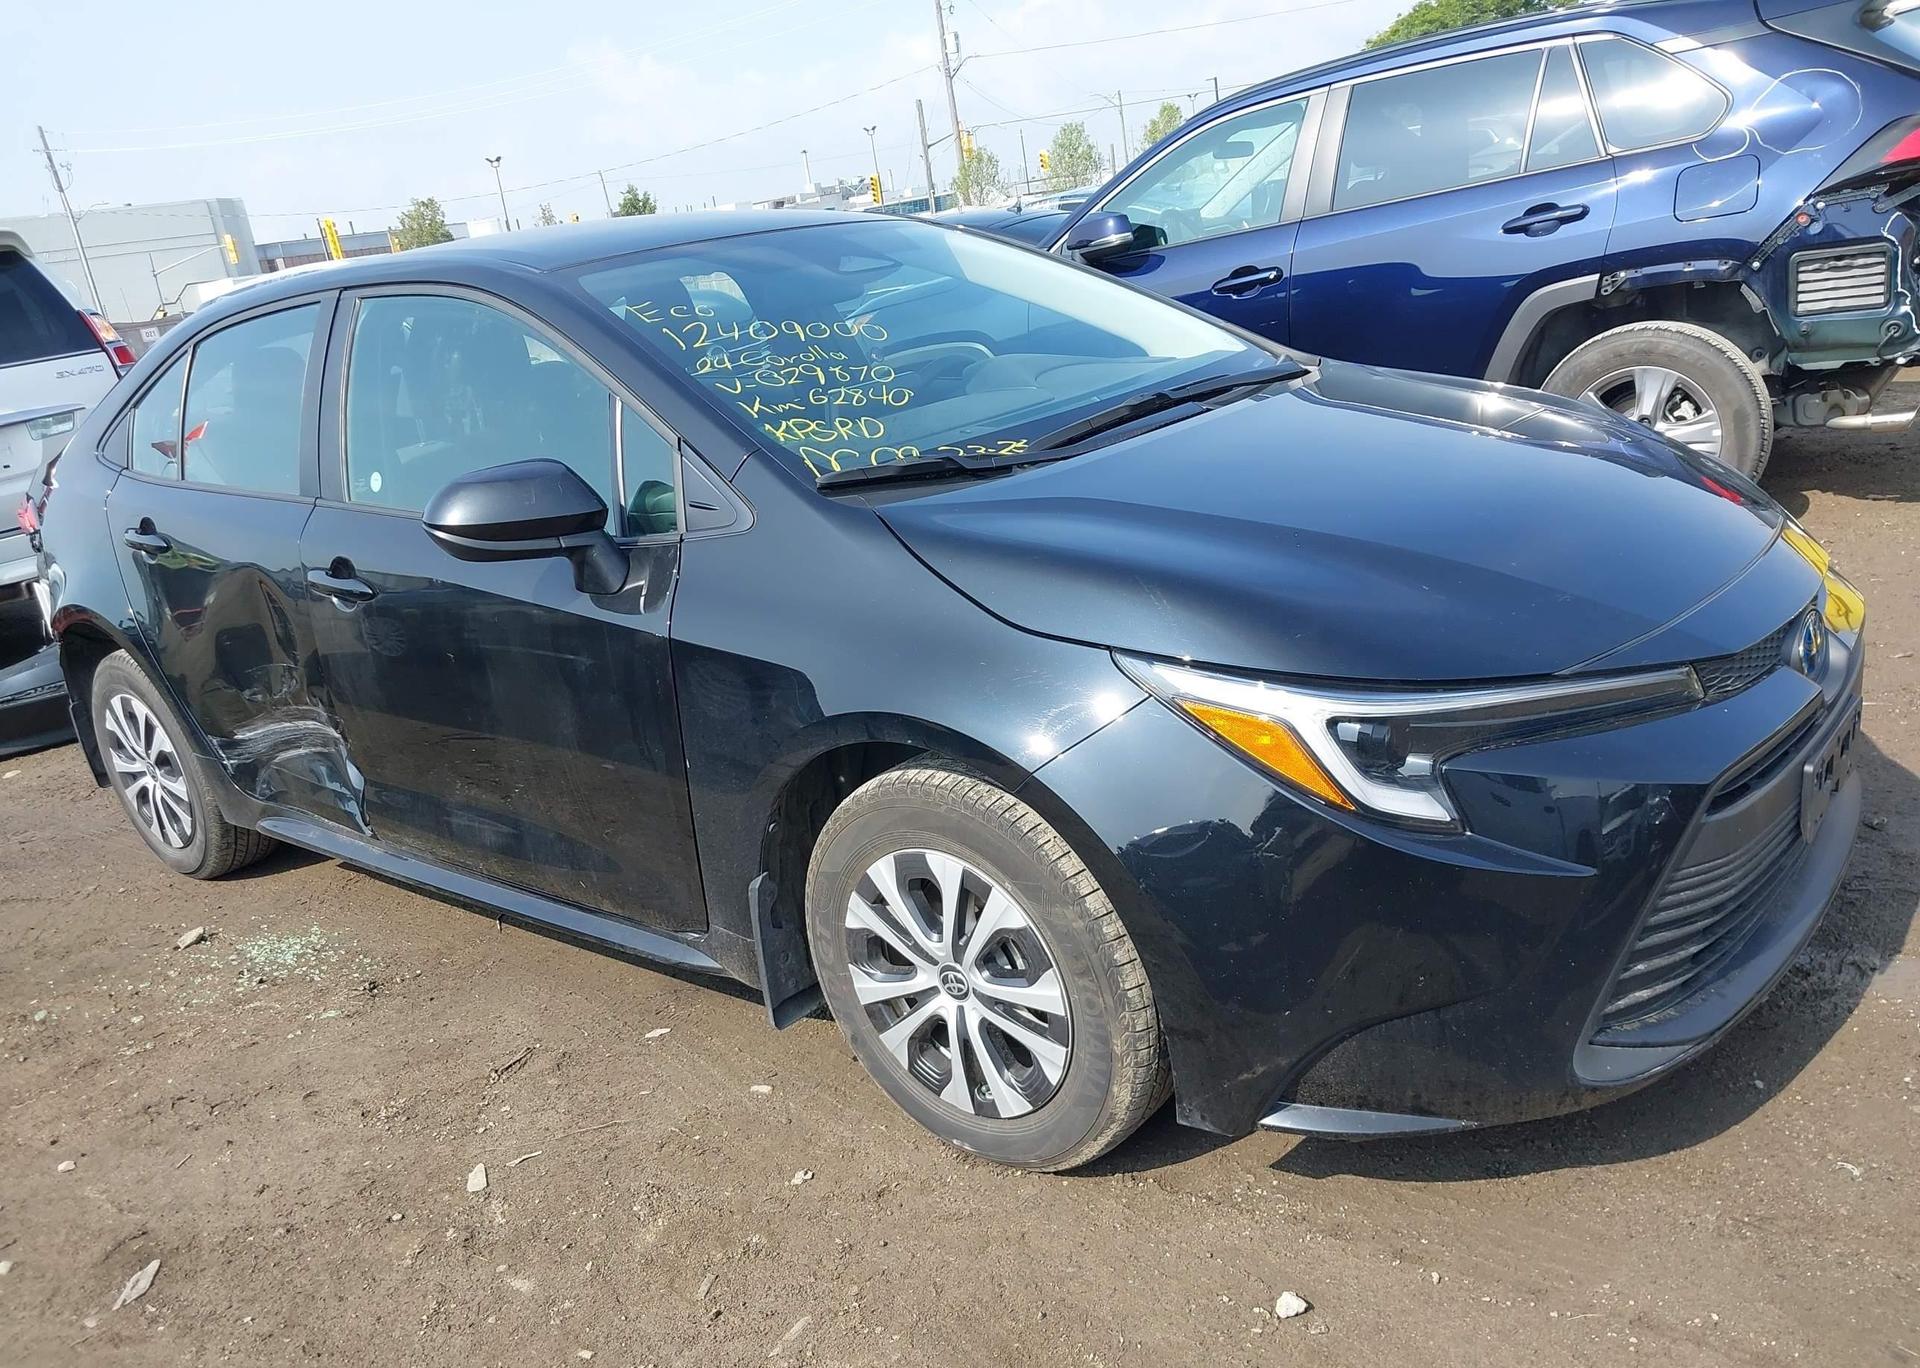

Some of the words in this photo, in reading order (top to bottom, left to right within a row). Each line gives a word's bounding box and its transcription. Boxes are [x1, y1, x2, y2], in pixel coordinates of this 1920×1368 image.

[662, 320, 888, 350] 12409000
[740, 344, 849, 367] Corolla
[809, 384, 915, 406] 62840
